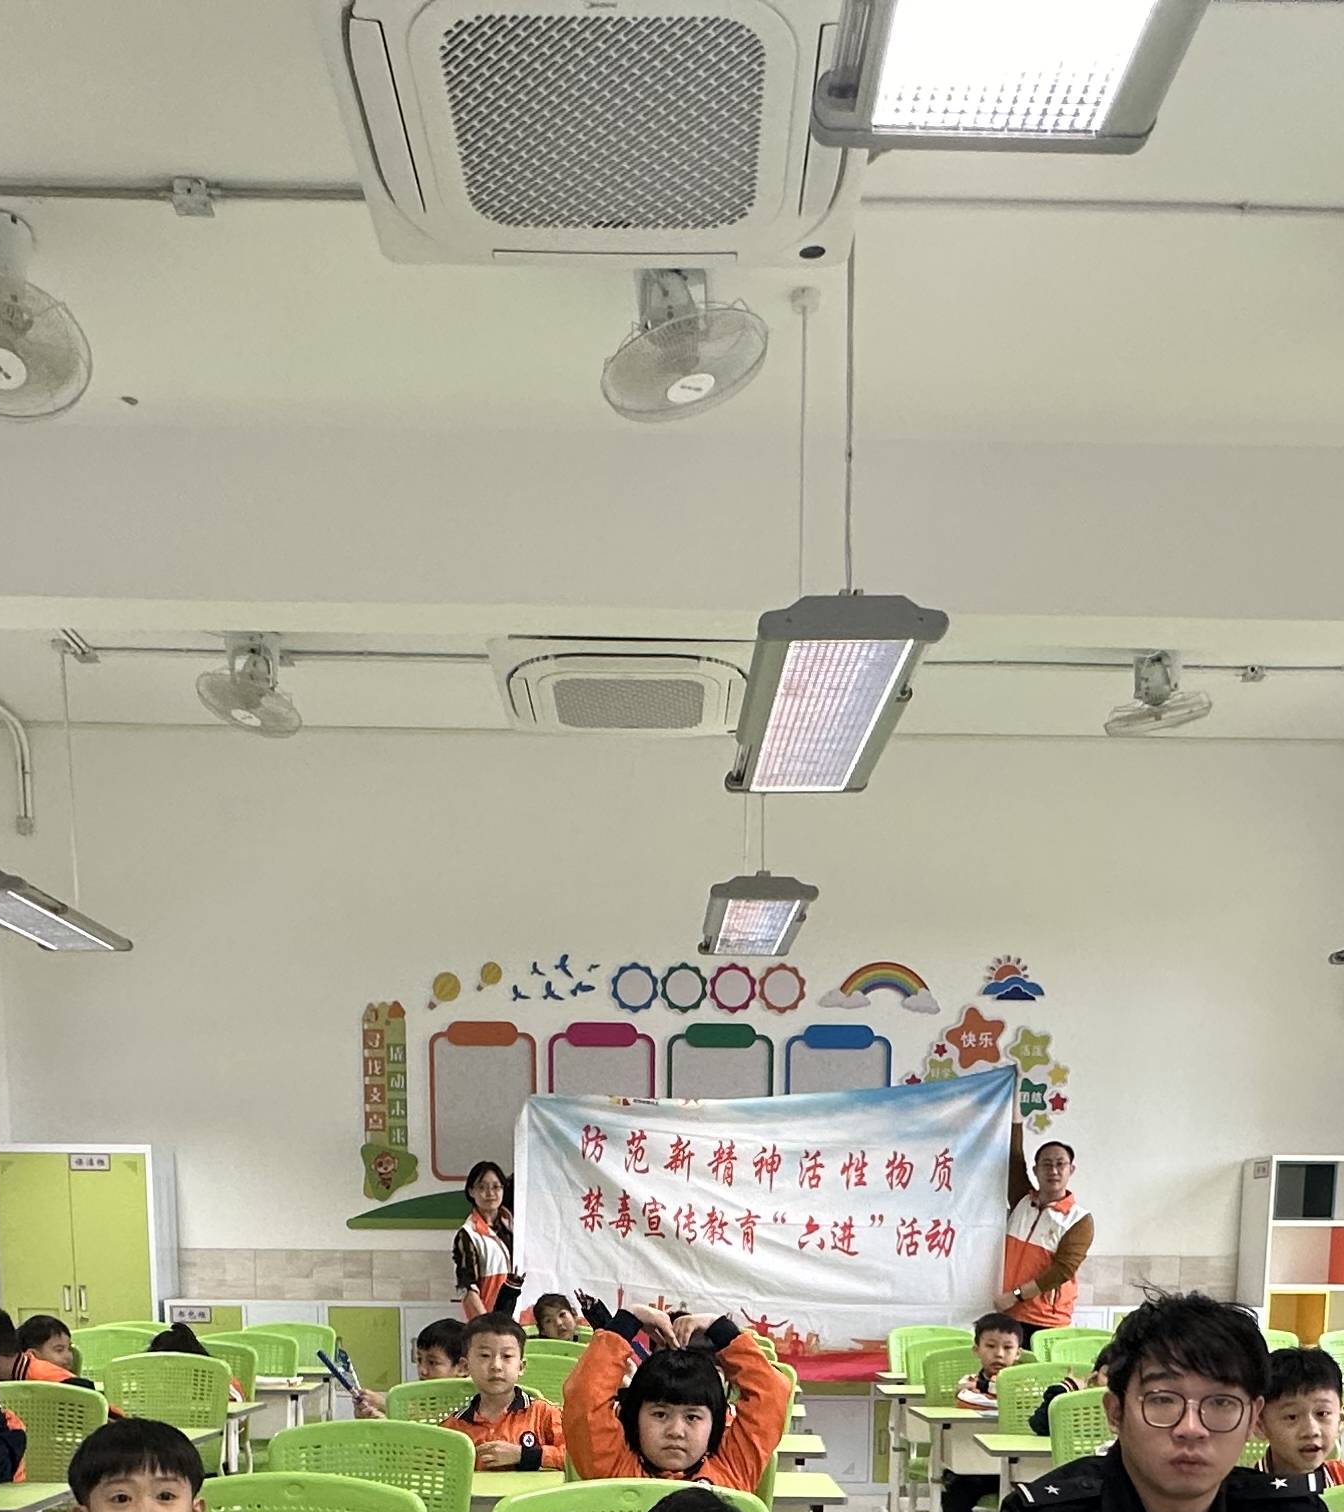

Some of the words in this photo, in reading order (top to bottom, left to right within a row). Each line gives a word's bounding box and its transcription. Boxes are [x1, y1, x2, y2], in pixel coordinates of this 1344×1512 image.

[960, 1031, 994, 1048] 快乐
[581, 1124, 955, 1194] 防范新精神活性物质
[579, 1188, 956, 1259] 禁毒宣传教育“六进”活动
